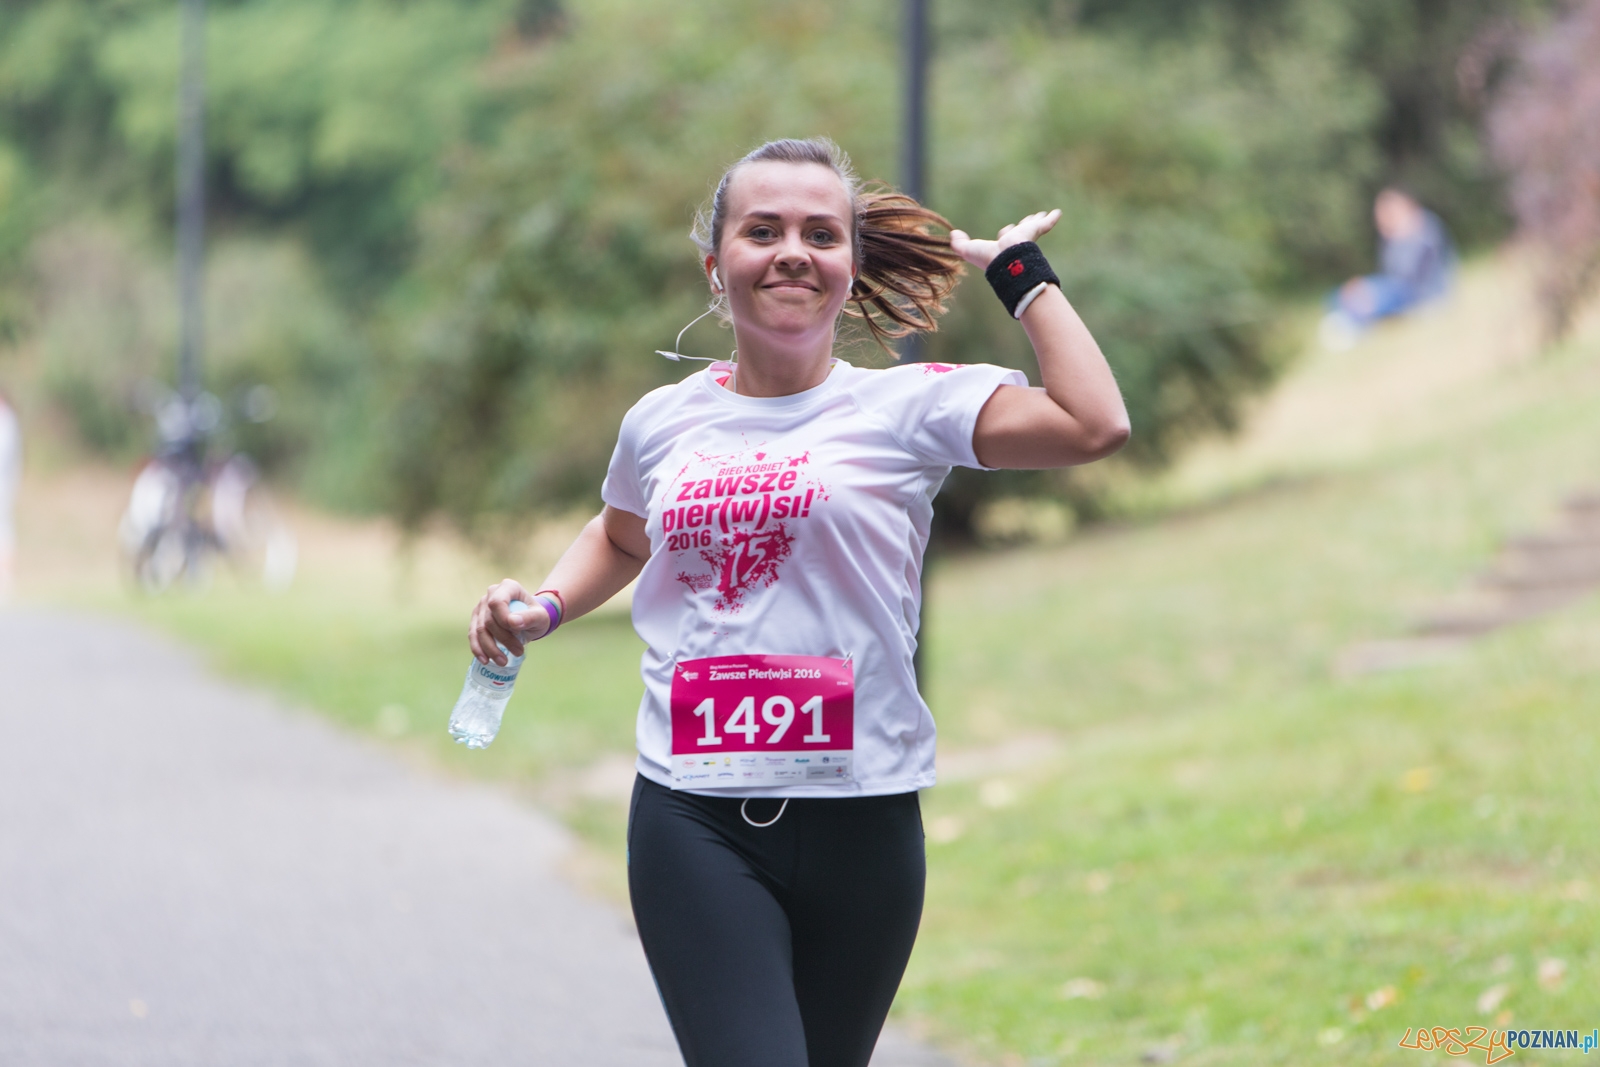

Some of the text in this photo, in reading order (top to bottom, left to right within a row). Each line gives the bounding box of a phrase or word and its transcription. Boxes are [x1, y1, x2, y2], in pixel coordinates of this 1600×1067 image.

[718, 462, 785, 477] BIEG KOBIET
[676, 470, 798, 502] zawsze
[667, 530, 712, 553] 2016
[708, 669, 747, 681] Zawsze
[748, 668, 792, 680] Pier(w)si
[794, 668, 821, 679] 2016
[692, 695, 831, 746] 1491
